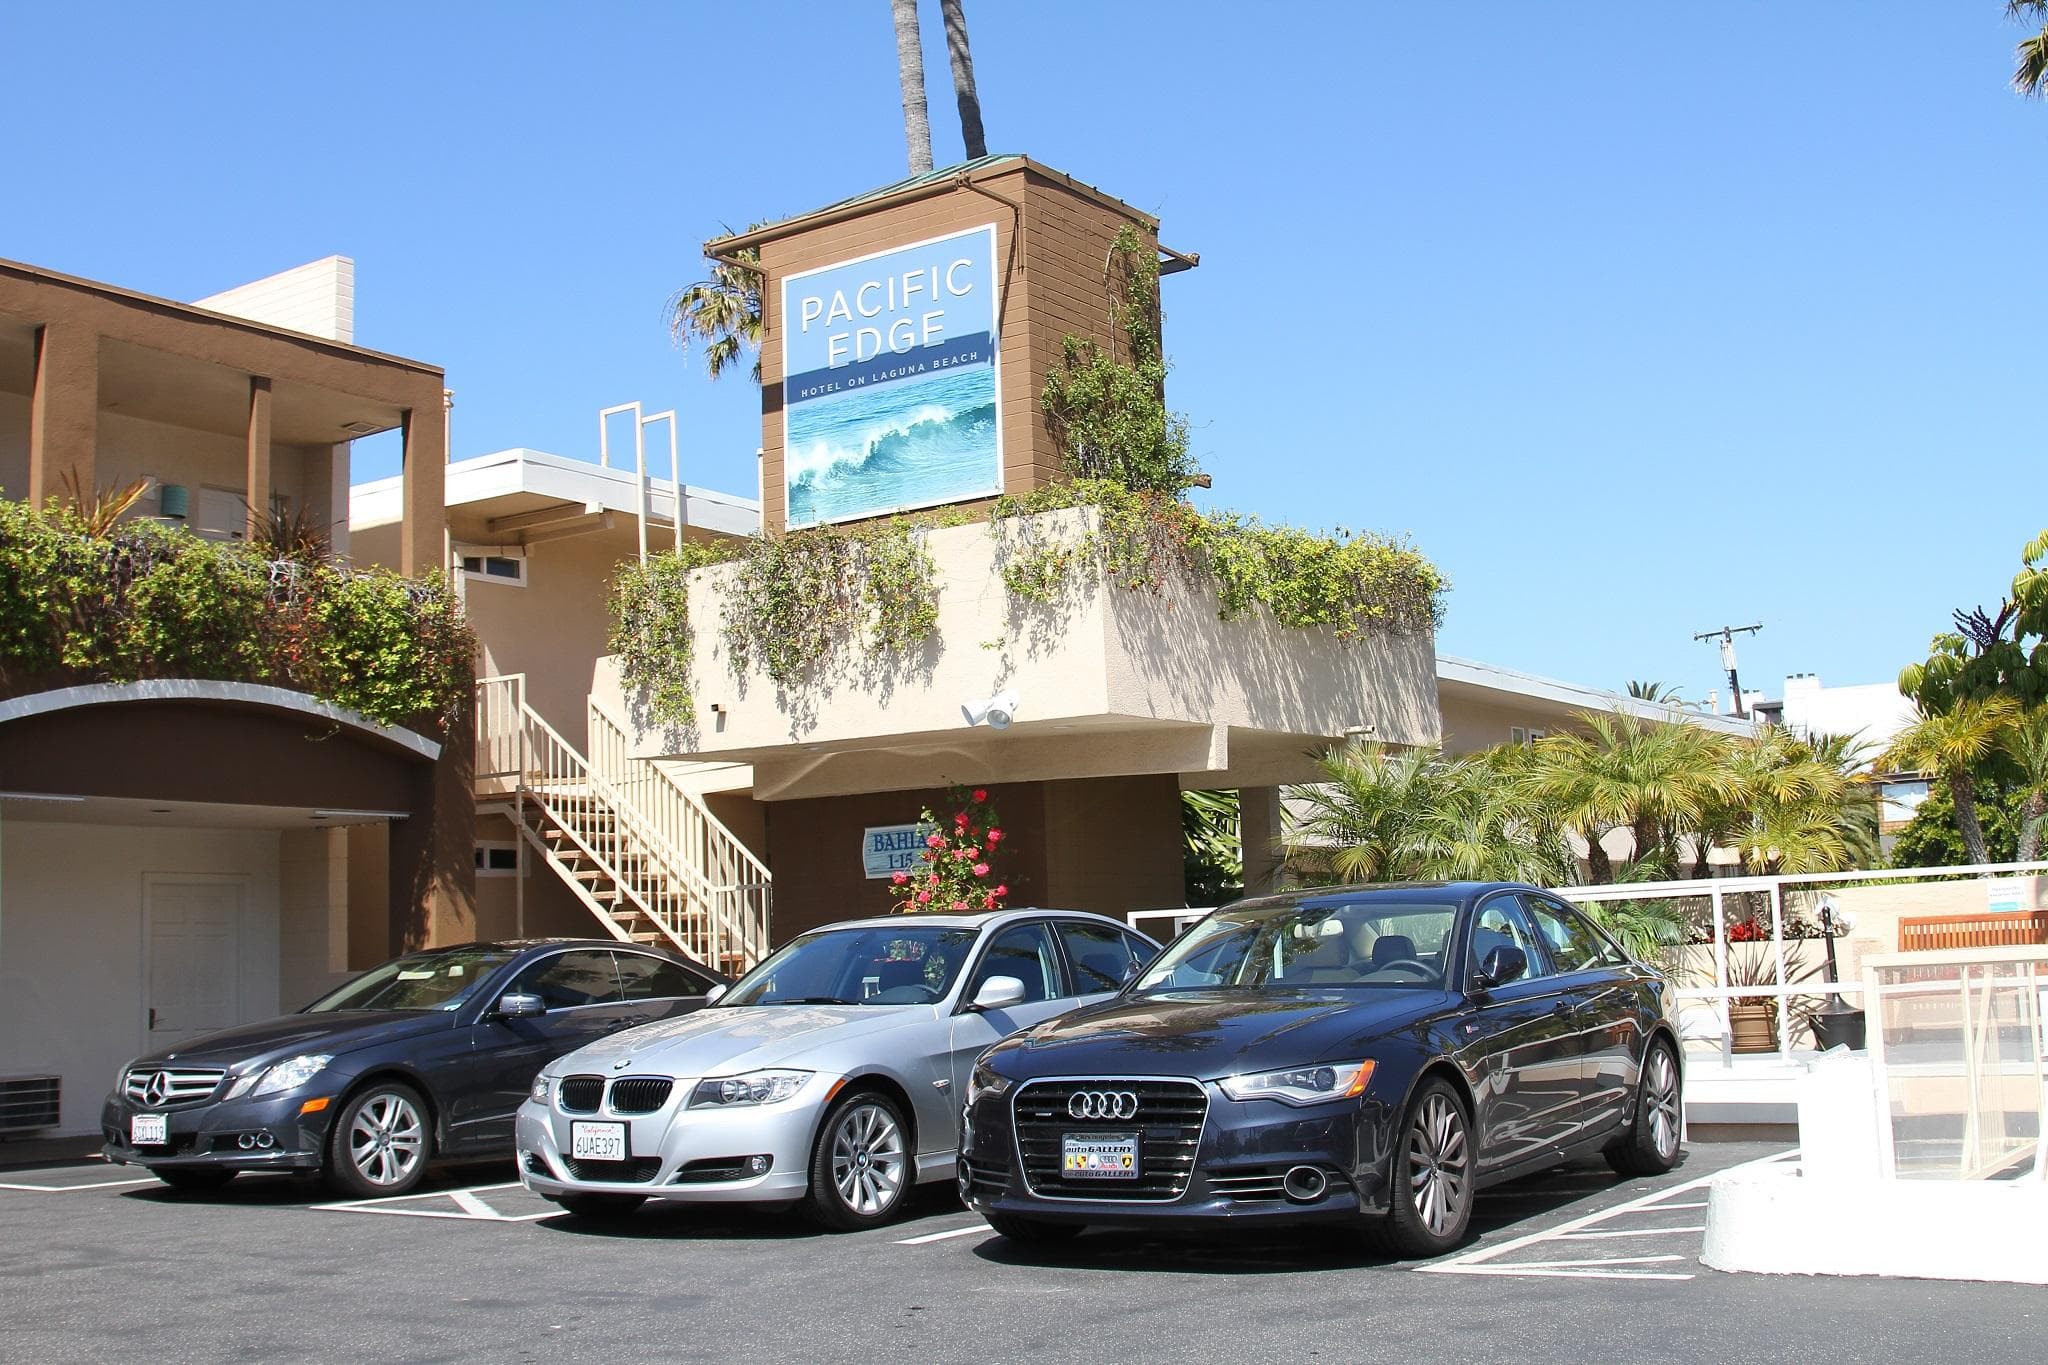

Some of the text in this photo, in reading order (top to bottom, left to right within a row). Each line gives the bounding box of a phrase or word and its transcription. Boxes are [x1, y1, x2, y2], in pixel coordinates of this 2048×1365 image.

[801, 258, 973, 334] PACIFIC
[828, 310, 945, 369] EDGE
[801, 351, 978, 398] HOTEL ON LAGUNA BEACH
[873, 832, 928, 852] BAHIA
[576, 1137, 621, 1155] 6UAE397
